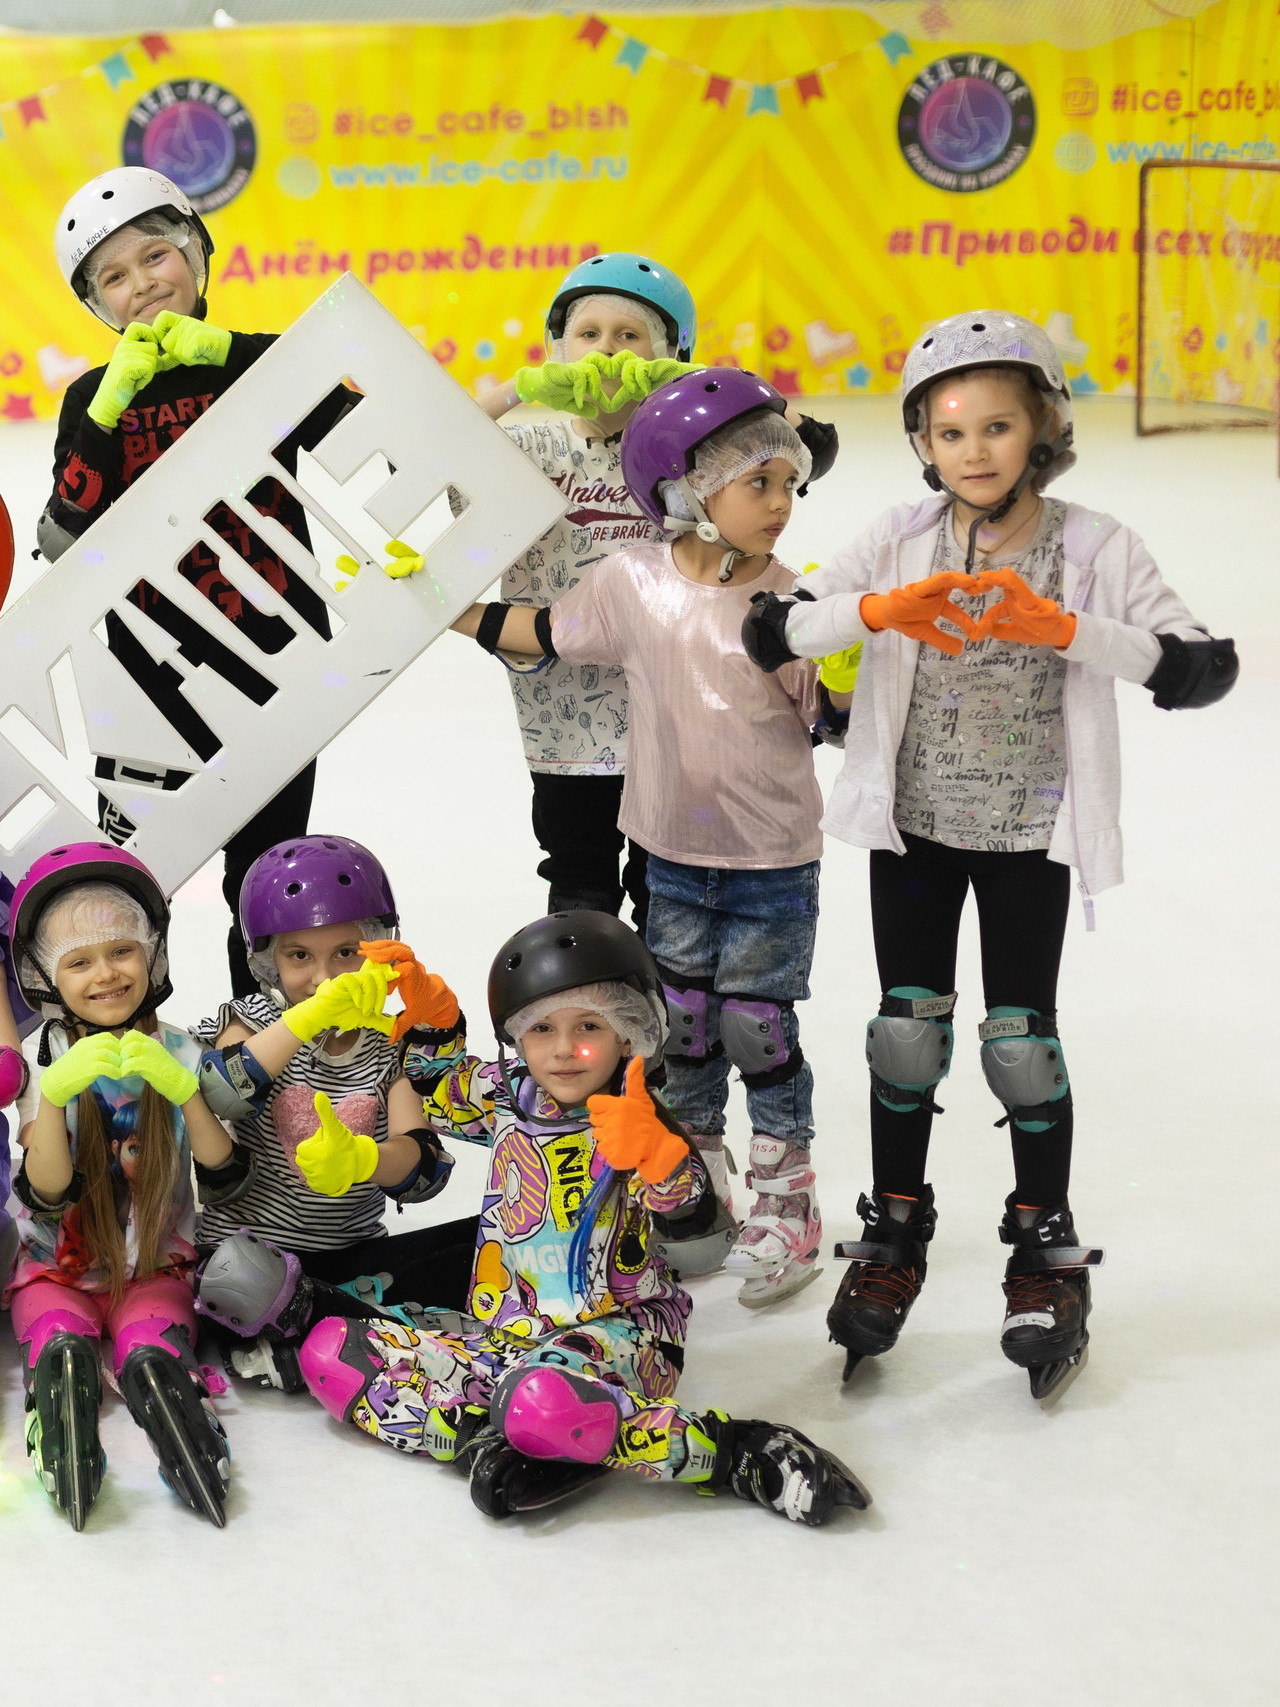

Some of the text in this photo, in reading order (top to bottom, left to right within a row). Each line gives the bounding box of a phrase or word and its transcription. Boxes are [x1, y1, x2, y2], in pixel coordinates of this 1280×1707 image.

[887, 215, 1119, 268] #Приводи
[221, 233, 602, 285] Днём рождения
[120, 392, 214, 432] START
[592, 524, 652, 541] BE BRAVE
[935, 752, 964, 769] OUI!
[986, 1025, 1021, 1034] CAPRICE
[737, 1450, 750, 1476] Prince
